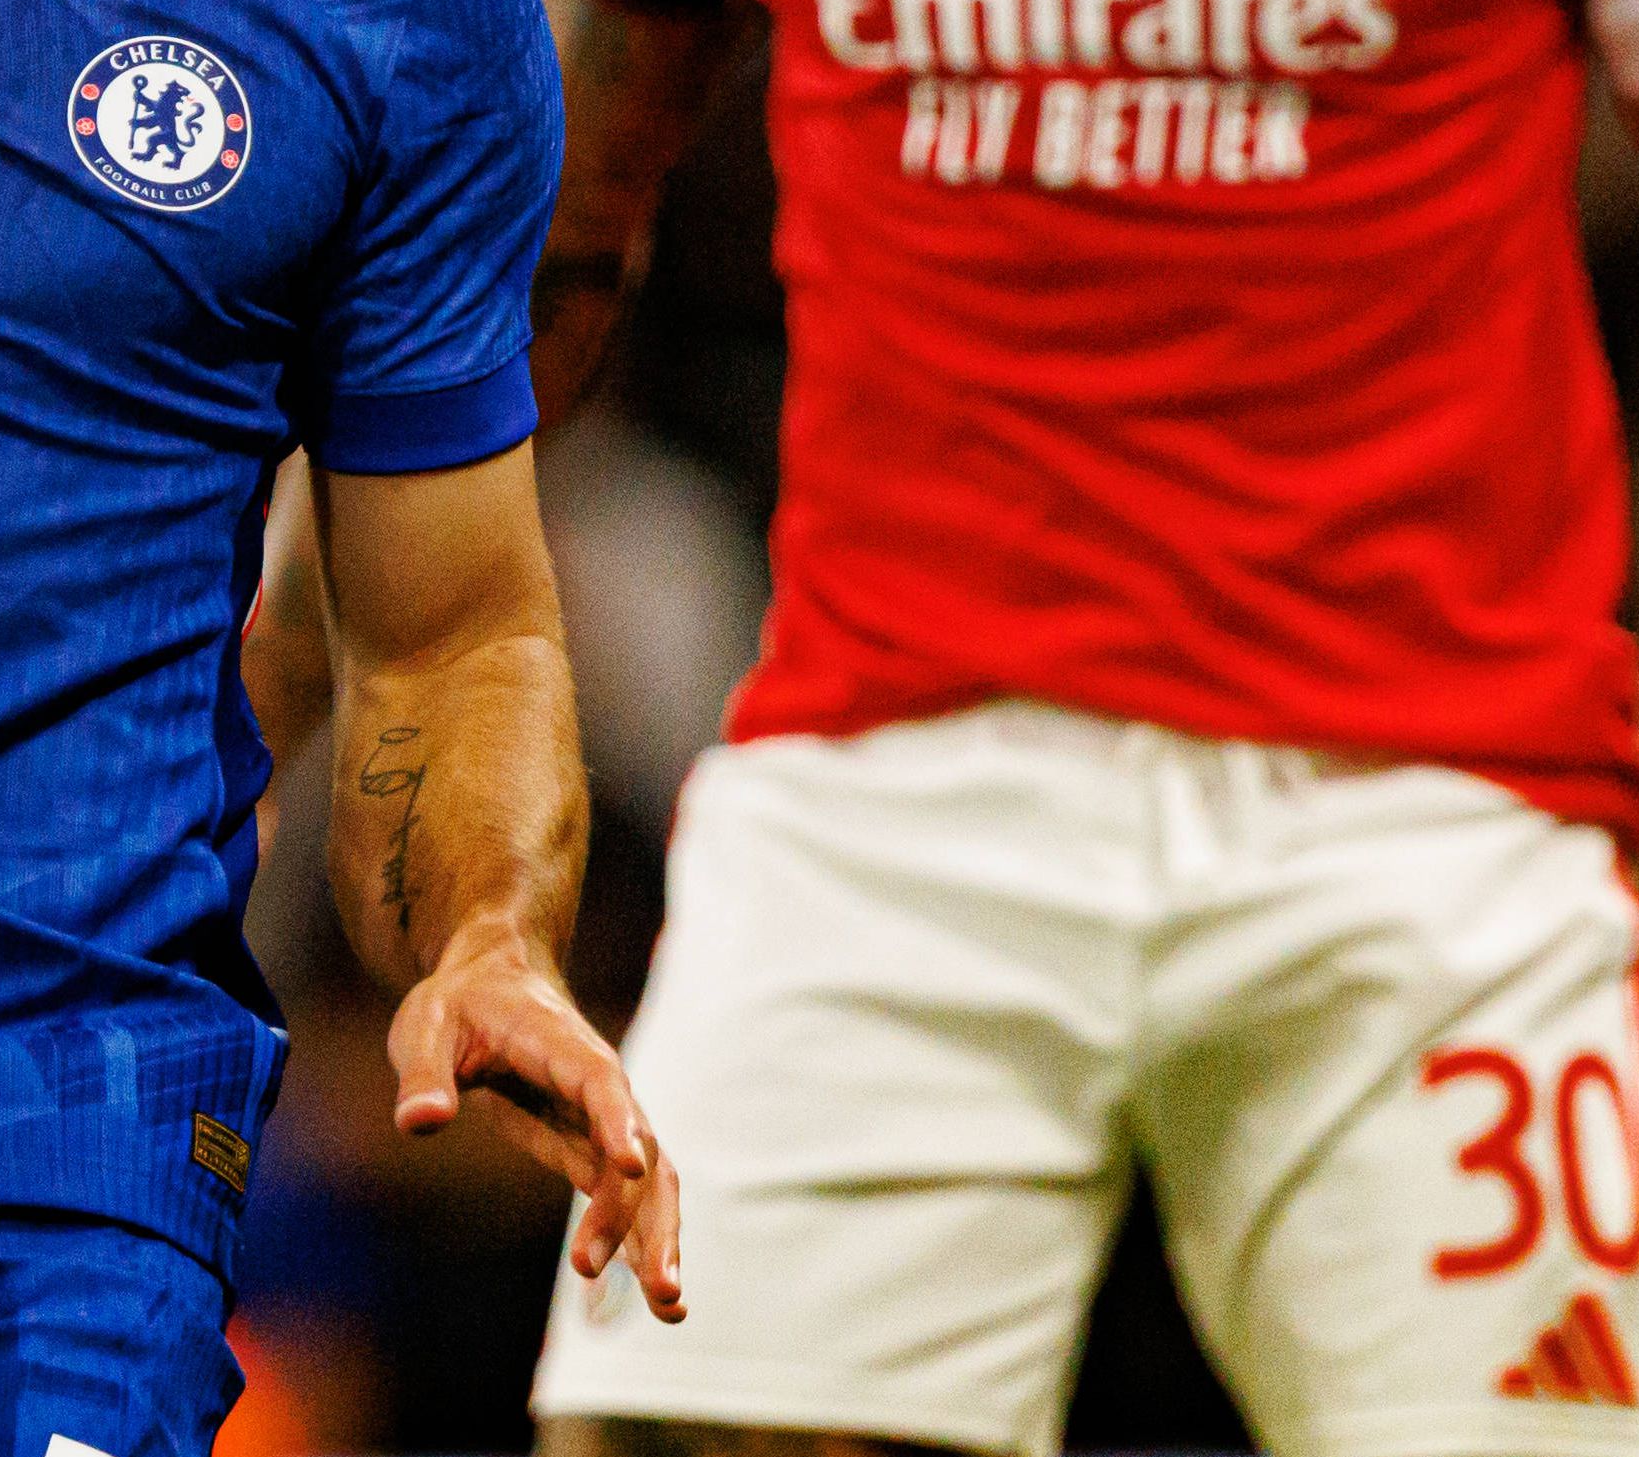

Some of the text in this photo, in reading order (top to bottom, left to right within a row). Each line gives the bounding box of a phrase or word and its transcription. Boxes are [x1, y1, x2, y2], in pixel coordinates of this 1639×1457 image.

[110, 43, 226, 91] CHELSEA
[1034, 77, 1311, 190] BETTER
[94, 156, 212, 201] FOOTBALL CLUB
